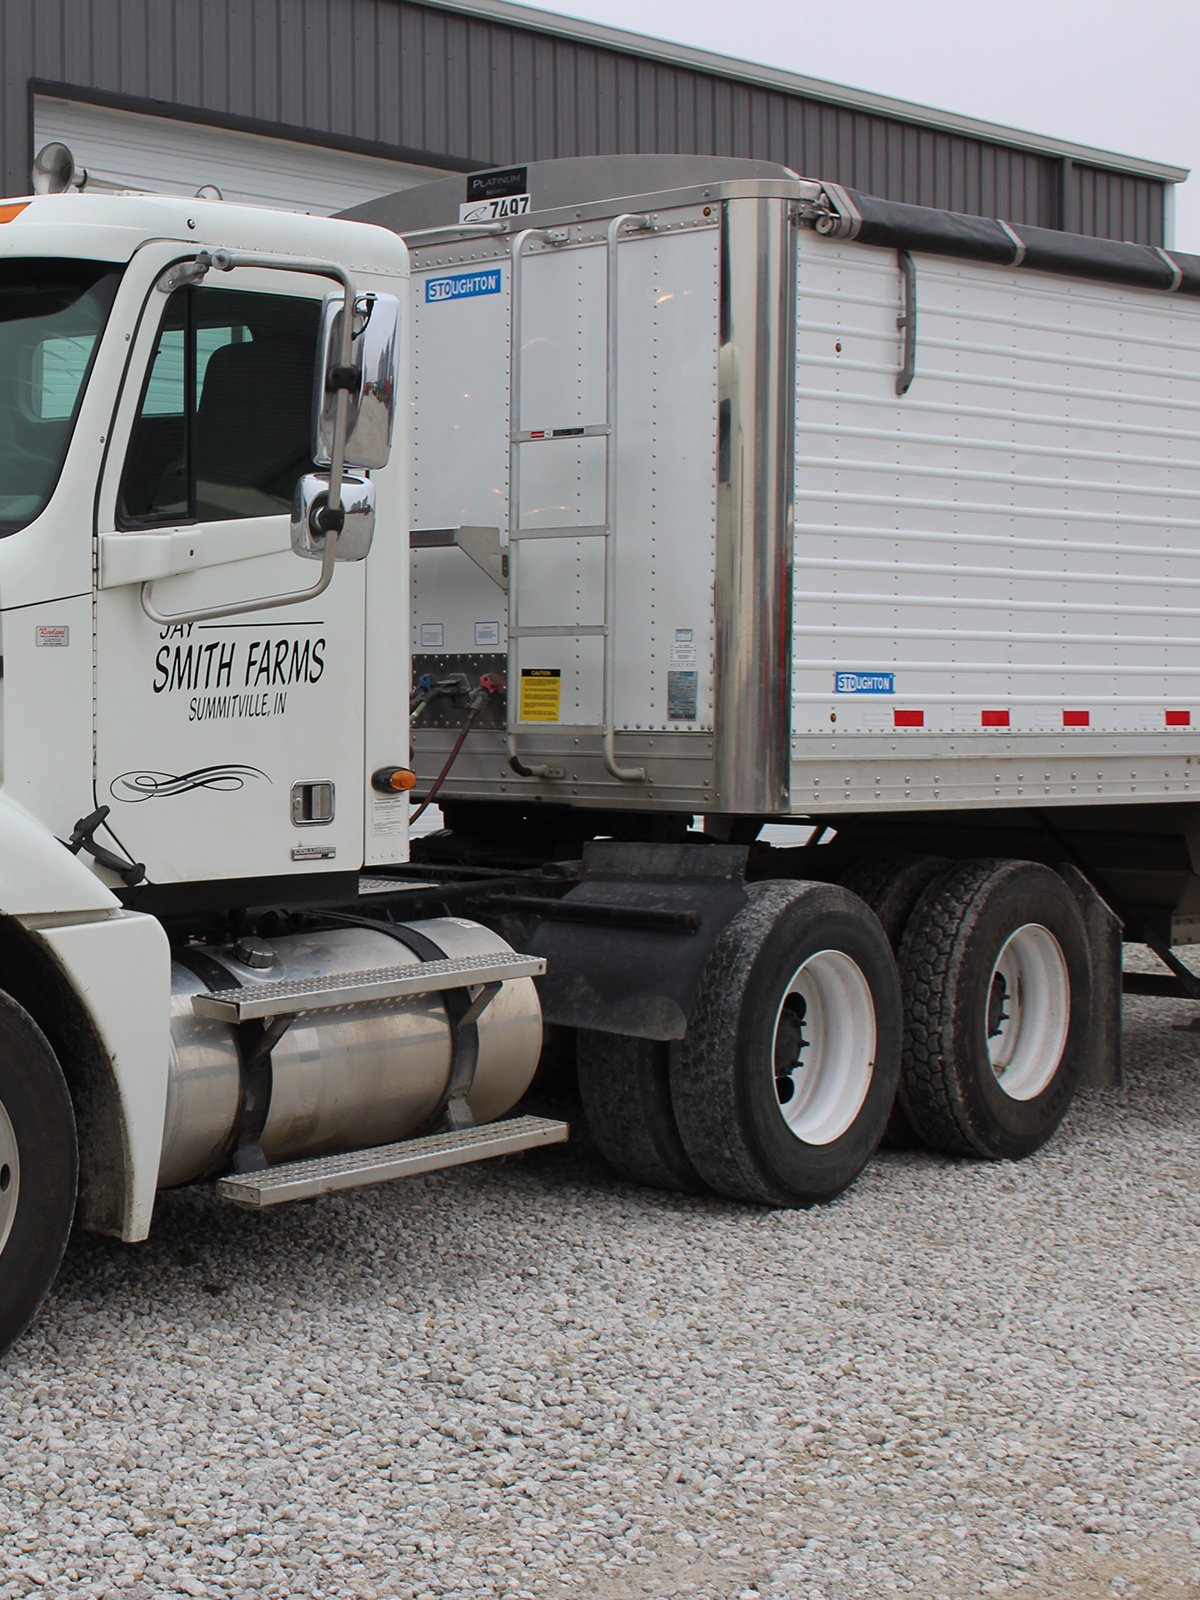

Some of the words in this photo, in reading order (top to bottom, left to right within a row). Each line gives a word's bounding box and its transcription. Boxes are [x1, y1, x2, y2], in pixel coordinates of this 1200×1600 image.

[472, 174, 521, 189] PLATINUM
[489, 196, 529, 219] 7497
[429, 275, 496, 298] STOUGHTON
[153, 642, 236, 693] SMITH
[245, 638, 326, 687] FARMS
[838, 676, 890, 690] STOUGHTON
[189, 693, 271, 722] SUMMITVILLE,
[273, 692, 288, 715] IN
